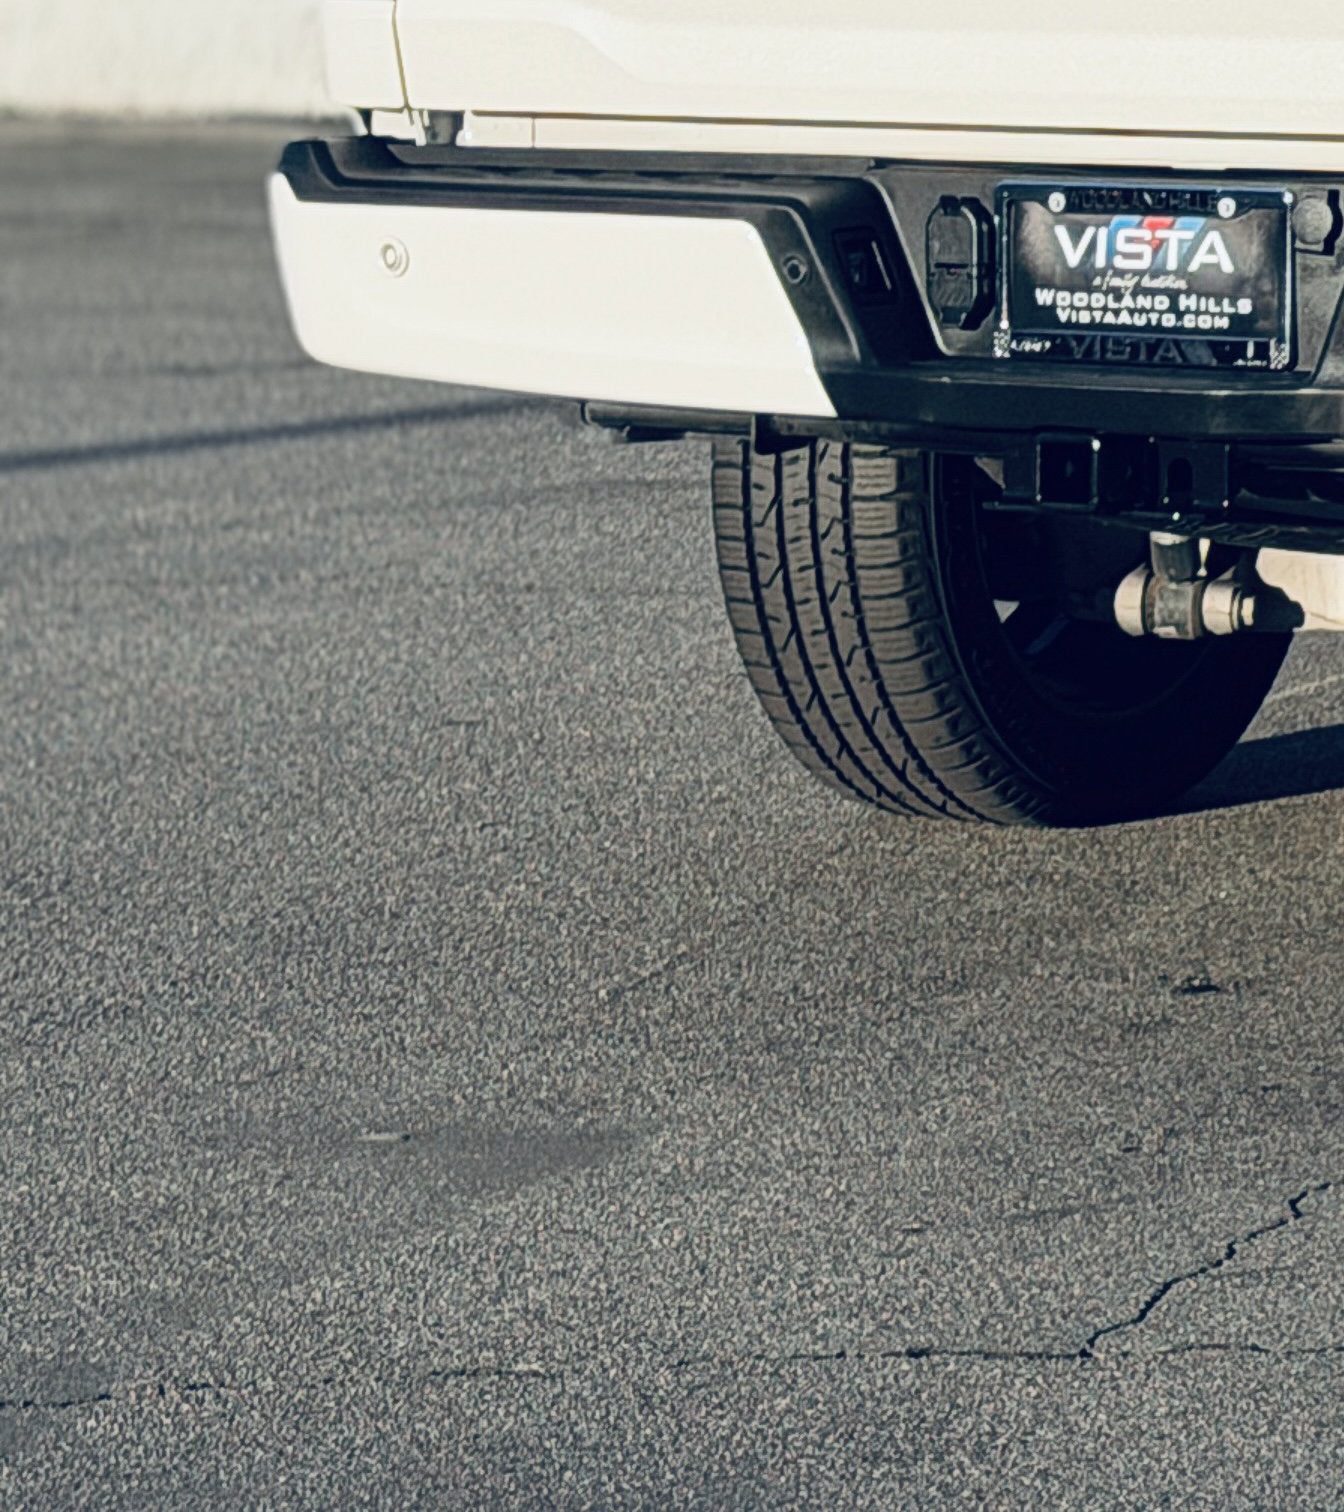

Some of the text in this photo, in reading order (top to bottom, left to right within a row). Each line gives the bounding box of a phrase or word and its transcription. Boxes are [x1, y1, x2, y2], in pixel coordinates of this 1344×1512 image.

[1053, 224, 1235, 274] VISTA
[1034, 287, 1253, 315] WOODLAND HILLS
